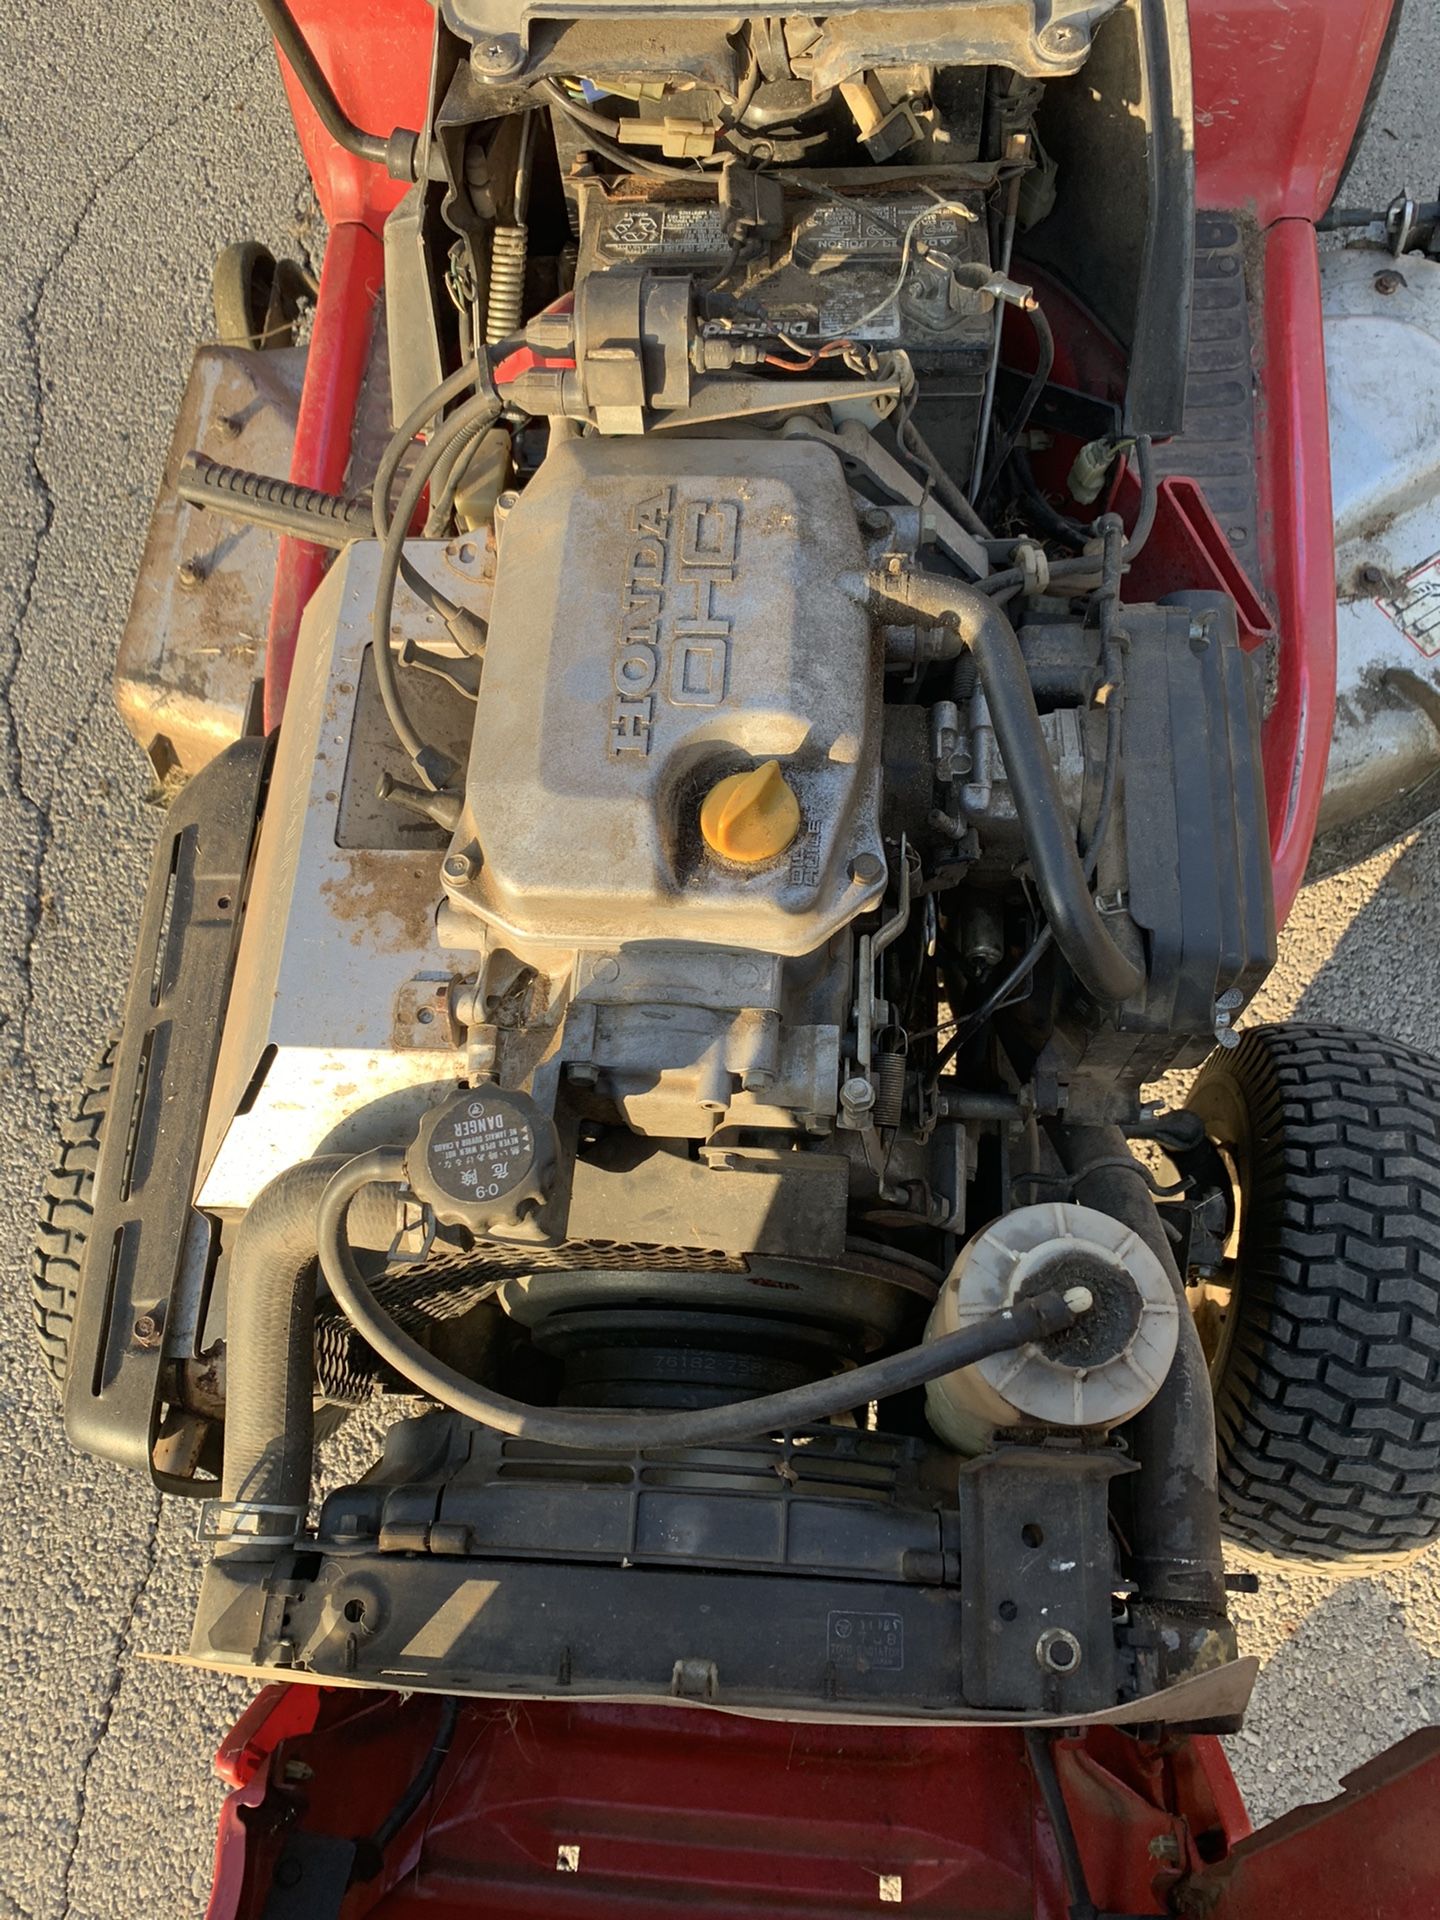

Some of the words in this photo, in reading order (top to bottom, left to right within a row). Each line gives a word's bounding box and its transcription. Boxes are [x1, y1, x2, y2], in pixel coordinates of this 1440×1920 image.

[818, 240, 868, 248] POISON
[668, 500, 739, 707] OHC
[610, 486, 672, 757] HONDA
[454, 1114, 503, 1137] DANGER
[480, 1142, 496, 1151] OPEN
[499, 1137, 519, 1148] NEVER
[459, 1146, 477, 1155] WHEN
